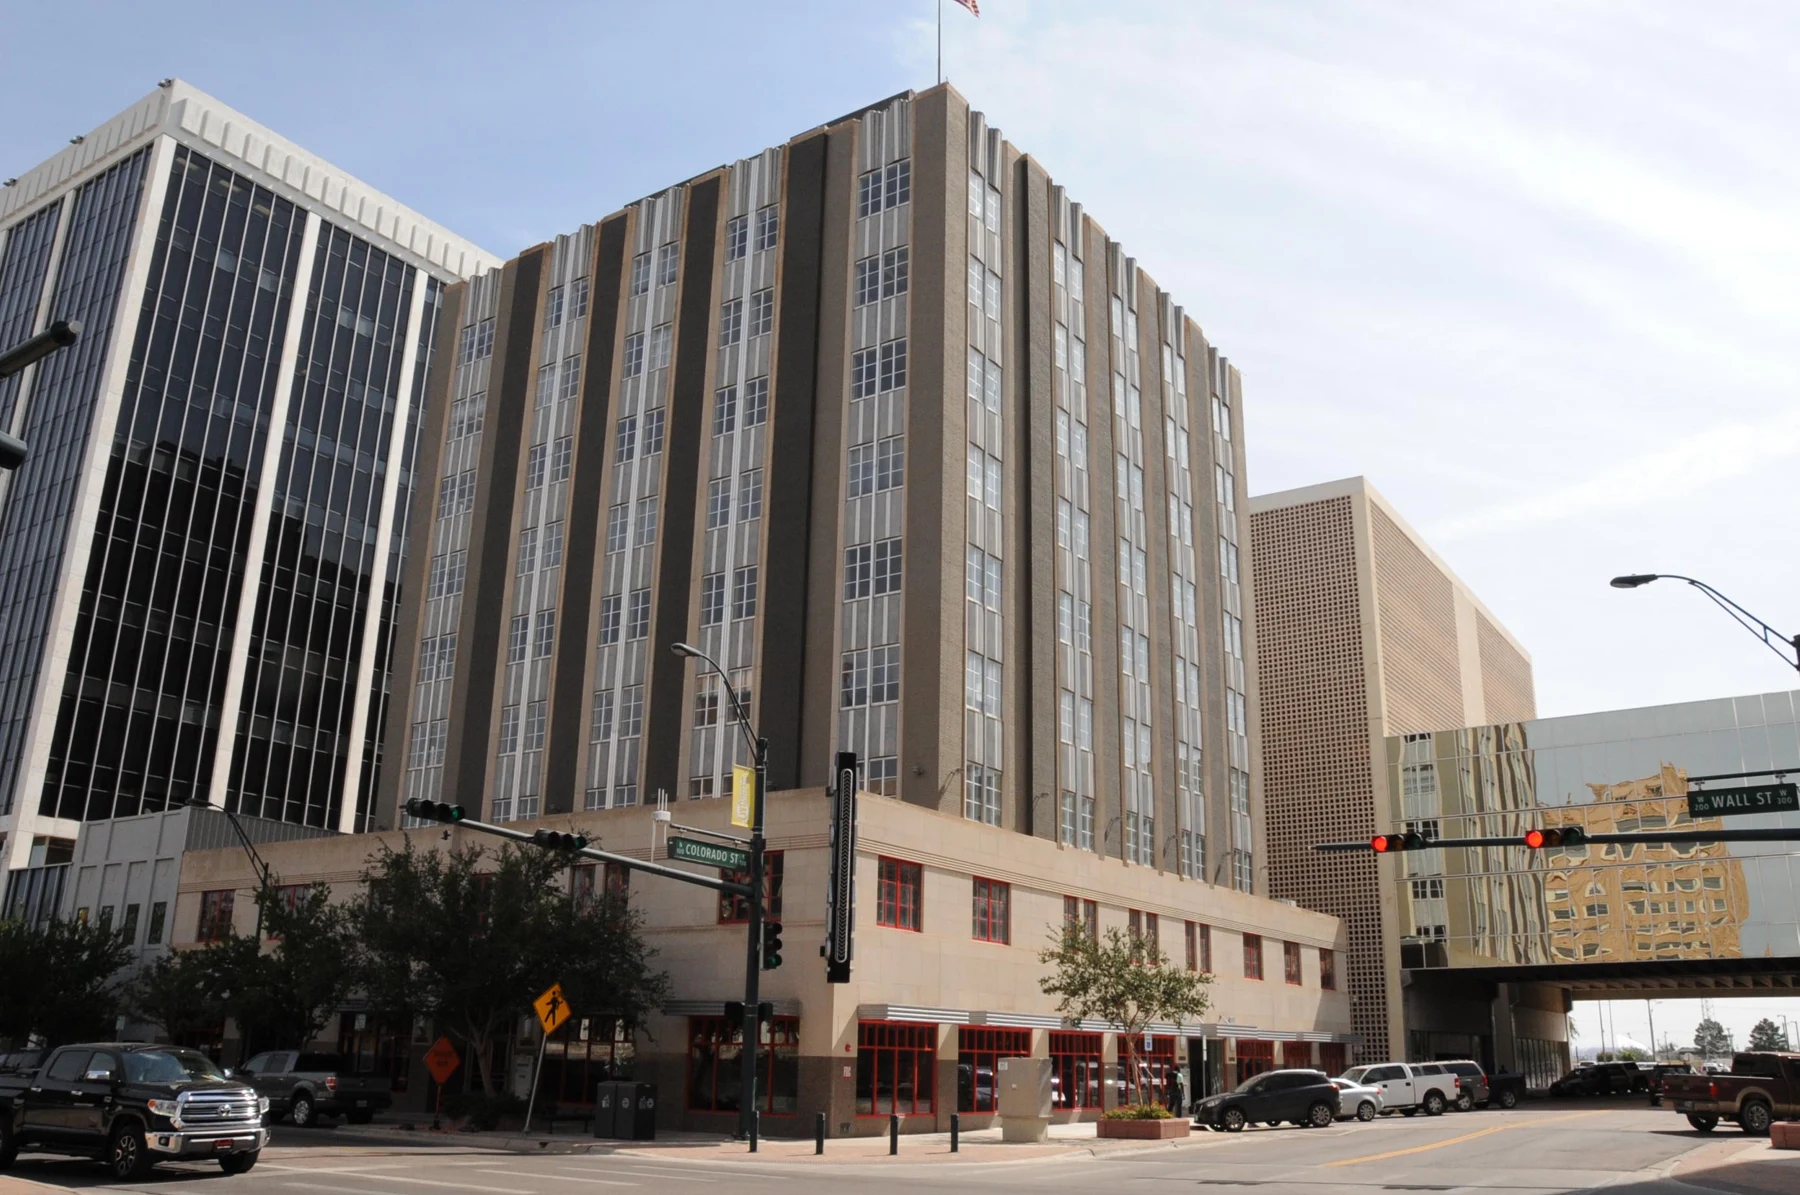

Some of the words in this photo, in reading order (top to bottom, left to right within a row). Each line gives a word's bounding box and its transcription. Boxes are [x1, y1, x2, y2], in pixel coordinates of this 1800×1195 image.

[1694, 803, 1710, 811] 200
[1711, 794, 1751, 808] WALL
[1756, 792, 1772, 805] ST
[685, 844, 728, 861] COLORADO
[730, 853, 739, 864] ST
